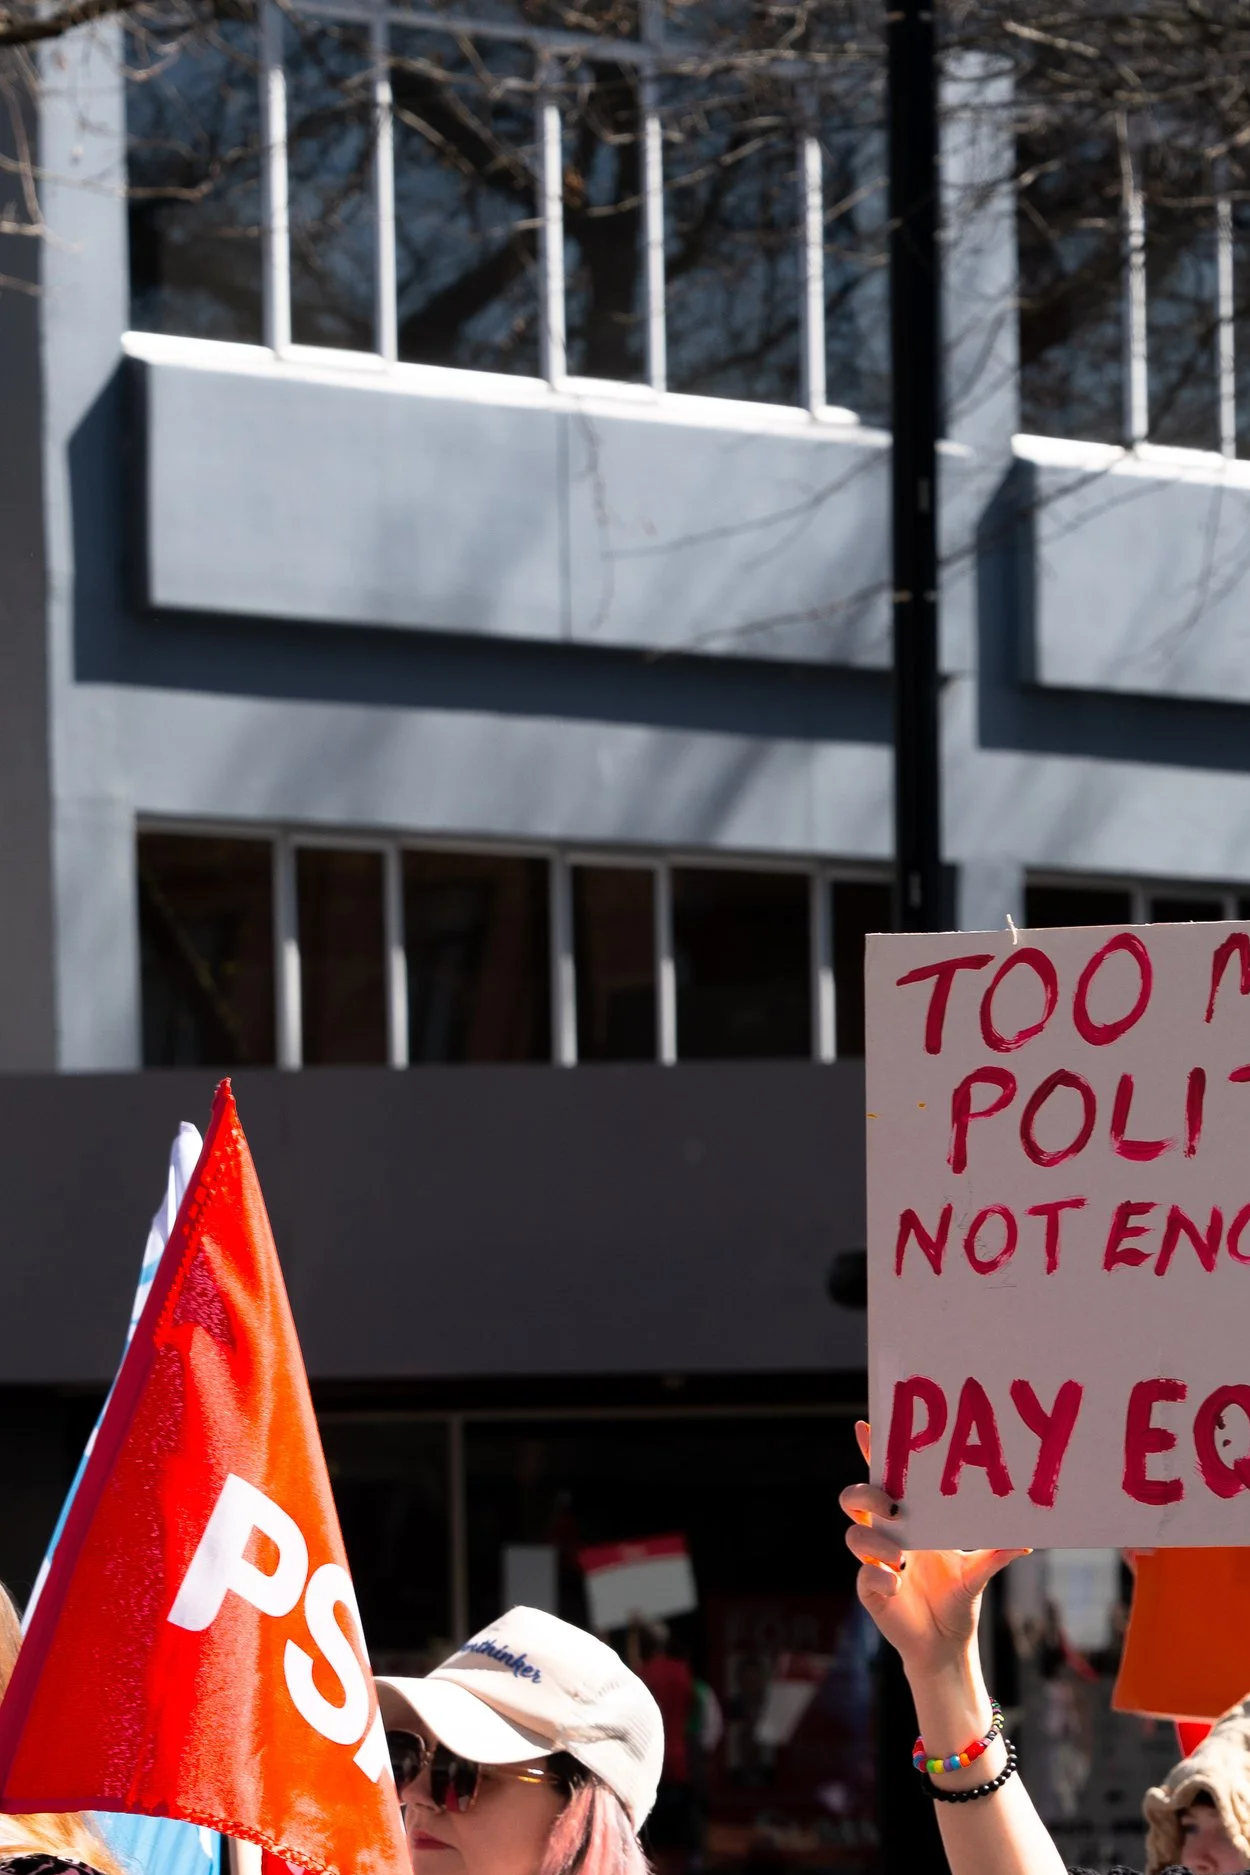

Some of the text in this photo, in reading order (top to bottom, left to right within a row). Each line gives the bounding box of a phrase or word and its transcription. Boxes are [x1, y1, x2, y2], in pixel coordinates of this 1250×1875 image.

[897, 931, 1154, 1055] TOO
[896, 1195, 1087, 1277] NOT
[883, 1375, 1083, 1508] PAY
